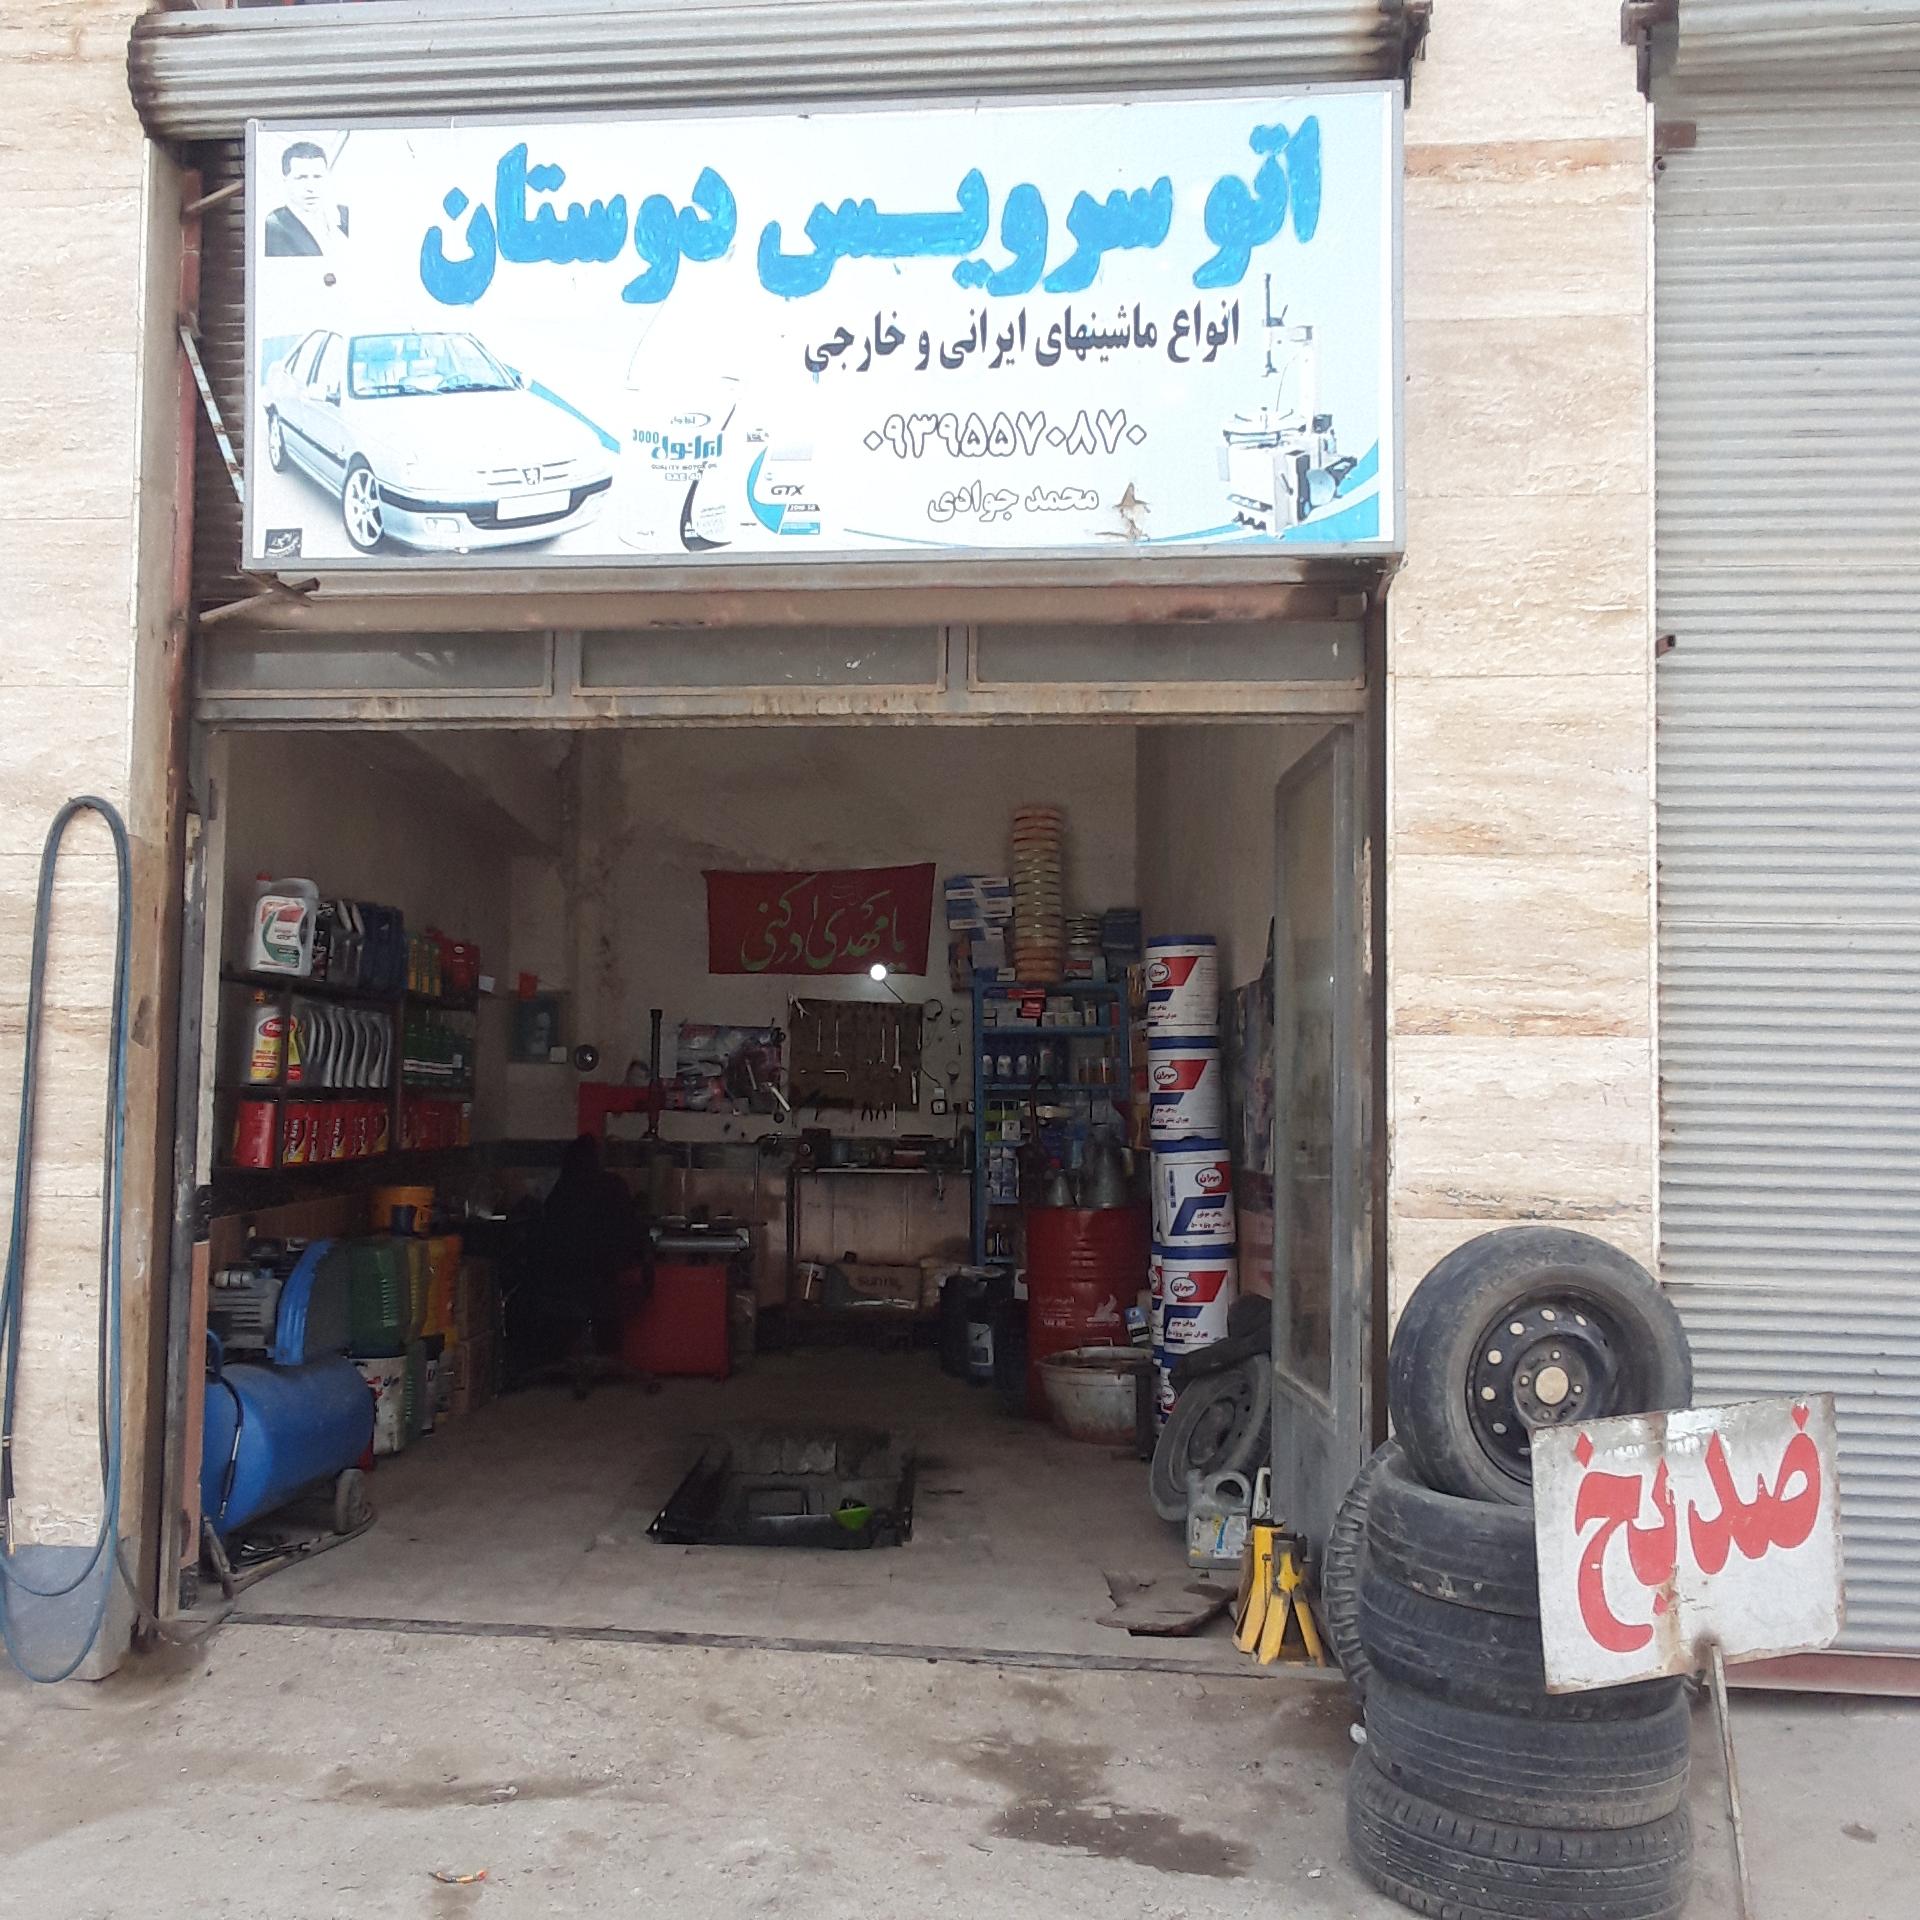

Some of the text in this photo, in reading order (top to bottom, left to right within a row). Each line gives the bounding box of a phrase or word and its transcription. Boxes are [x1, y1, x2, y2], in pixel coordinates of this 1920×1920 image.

[420, 115, 1321, 305] اتو سرویس دوستان
[804, 299, 1240, 372] انواع ماشینهای ایرانی و خارجی
[651, 433, 723, 460] ایرانول
[770, 484, 805, 497] GTX
[927, 479, 1100, 523] محمد جوادی
